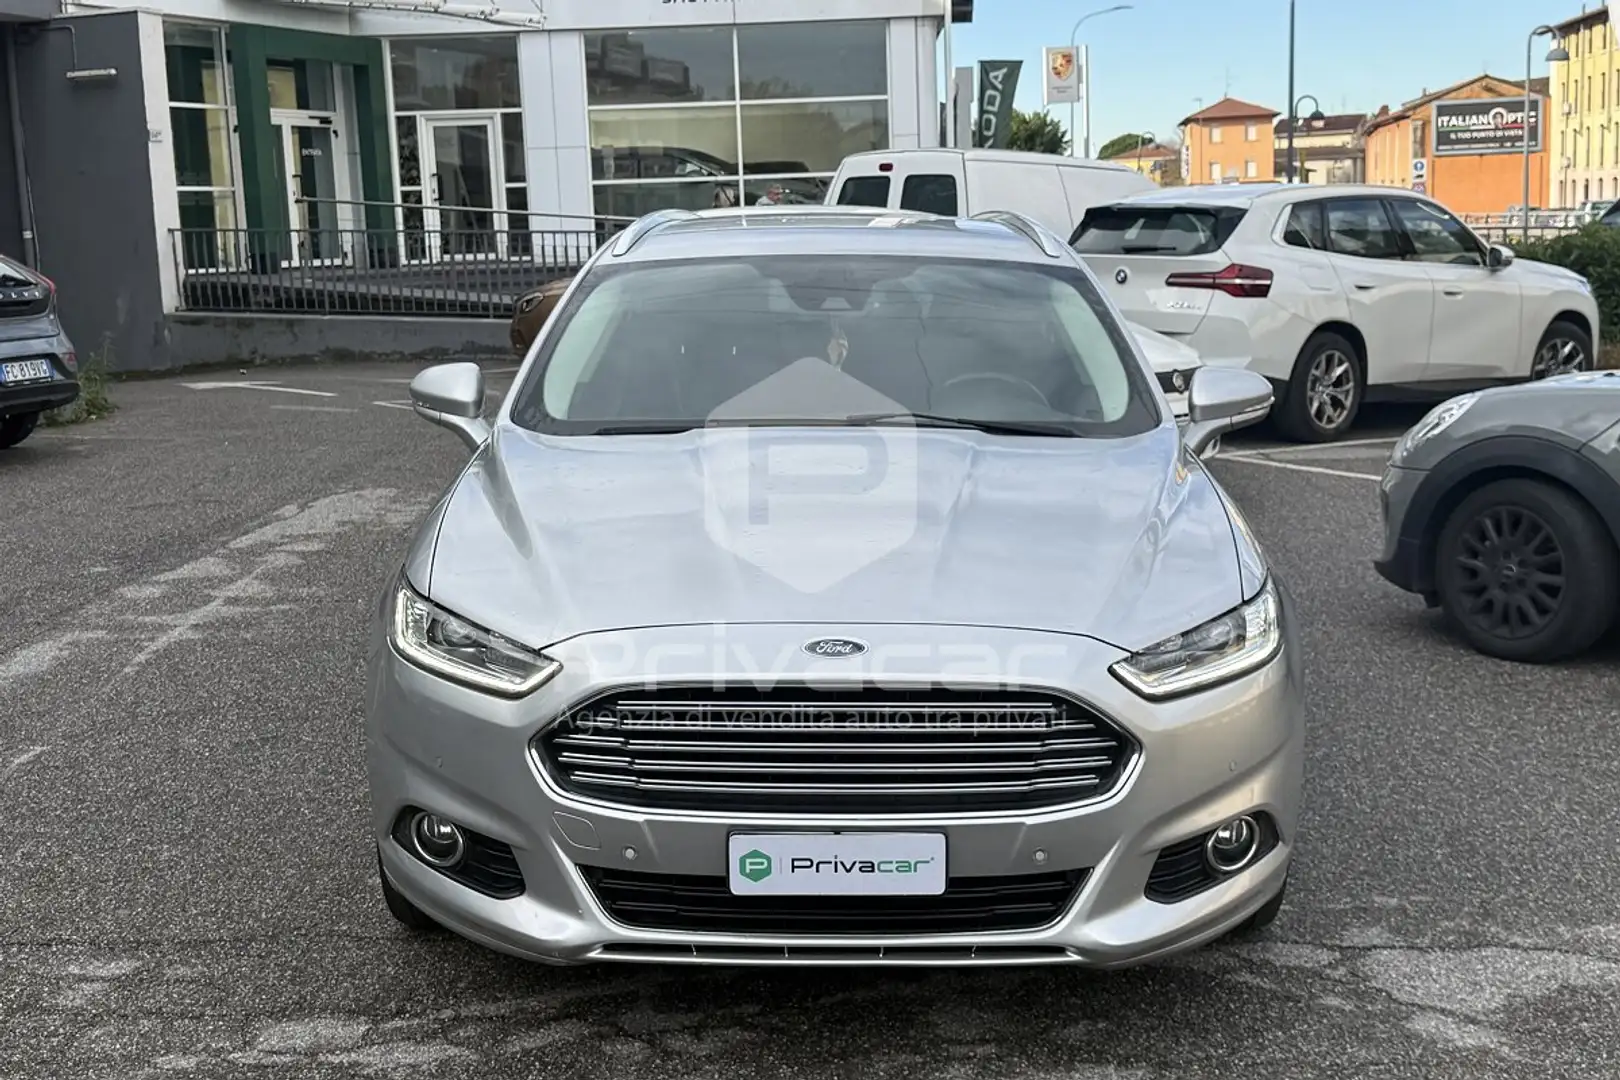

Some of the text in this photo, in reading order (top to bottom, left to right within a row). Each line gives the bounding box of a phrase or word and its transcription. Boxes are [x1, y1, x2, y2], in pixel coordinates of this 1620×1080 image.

[982, 67, 1008, 149] ODA
[816, 641, 853, 653] Ford
[791, 854, 930, 873] Privacar
